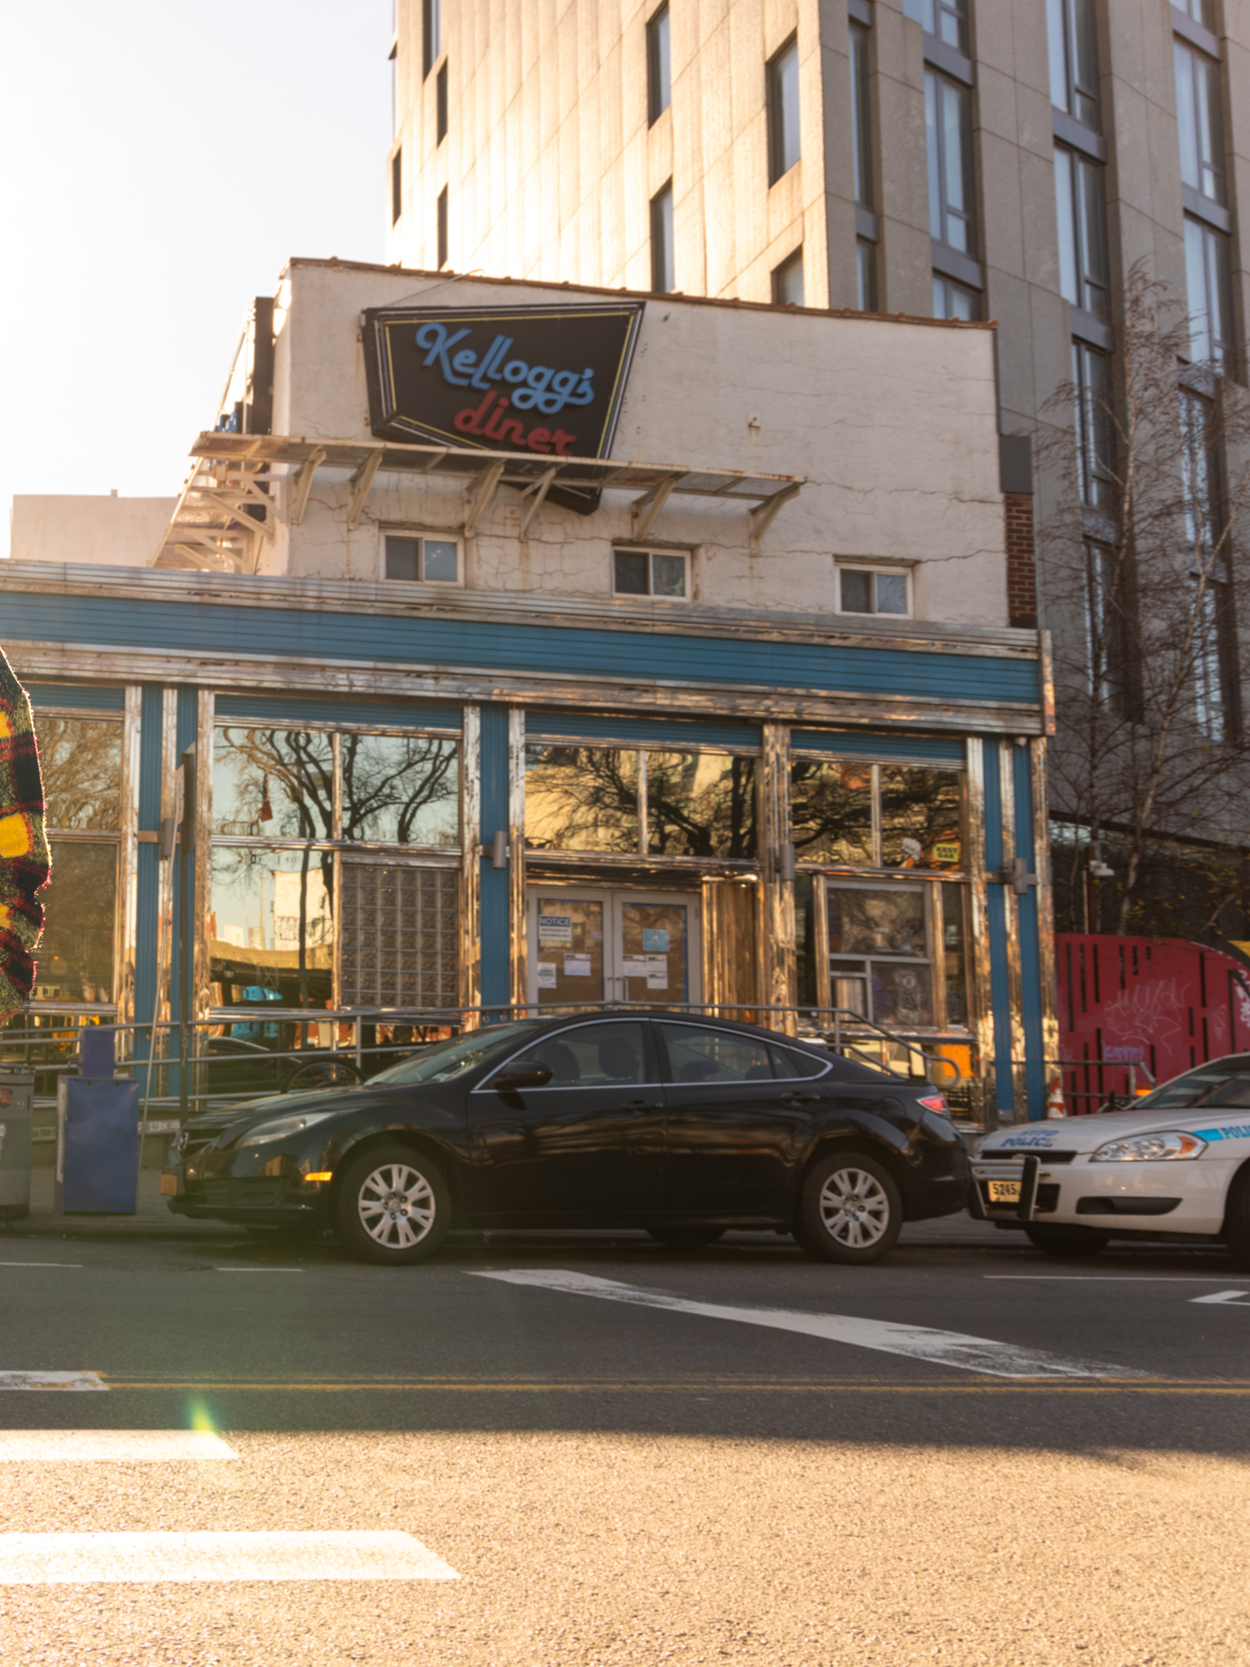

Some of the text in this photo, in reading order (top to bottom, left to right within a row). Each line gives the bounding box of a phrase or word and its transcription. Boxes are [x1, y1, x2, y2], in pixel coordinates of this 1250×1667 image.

[415, 322, 595, 414] Kellogg's
[453, 390, 578, 457] diner
[539, 917, 570, 926] NOTICE
